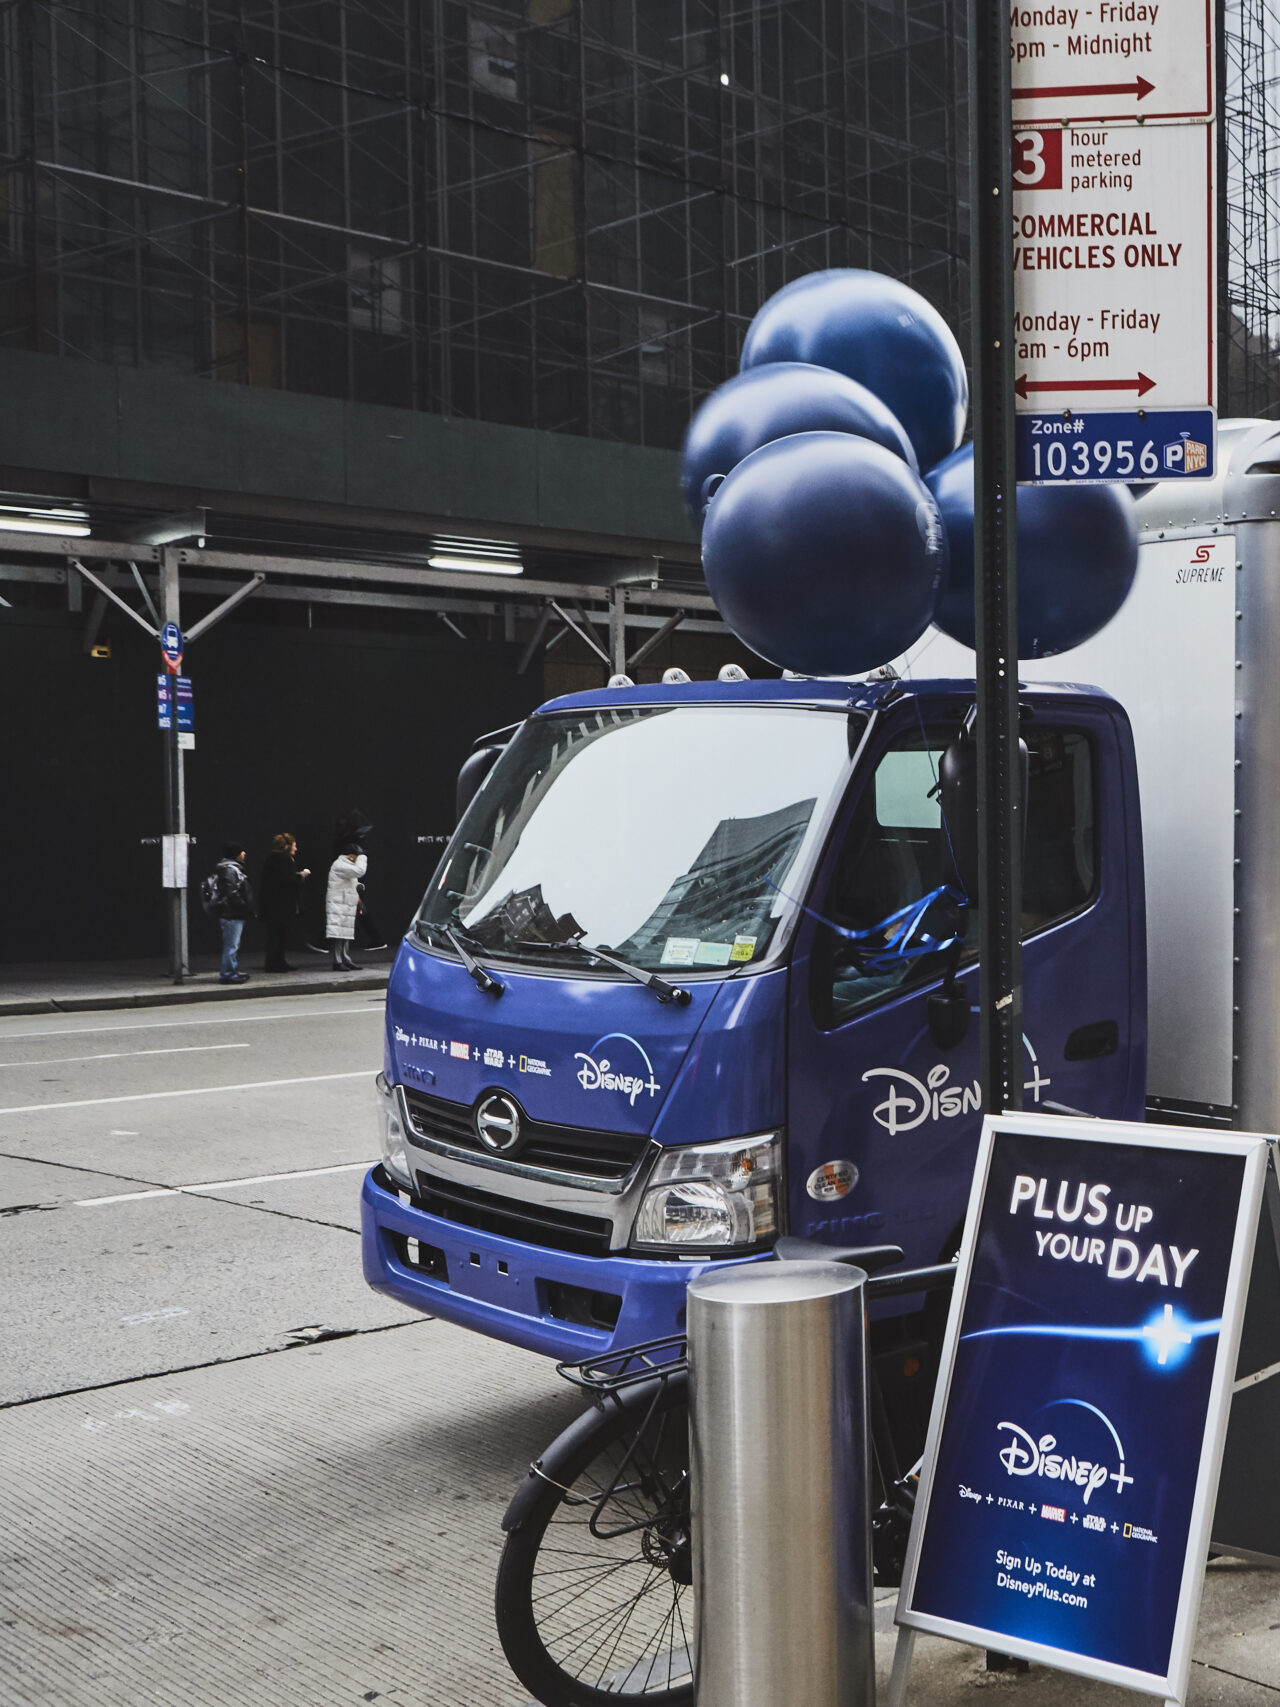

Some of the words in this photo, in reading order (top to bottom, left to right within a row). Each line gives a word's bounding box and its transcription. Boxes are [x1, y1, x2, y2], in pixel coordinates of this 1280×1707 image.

[1100, 2, 1159, 25] Friday
[1067, 32, 1152, 57] Midnight
[1071, 129, 1108, 146] hour
[1012, 131, 1046, 185] 3
[1071, 149, 1141, 167] metered
[1071, 171, 1133, 192] parking
[1124, 243, 1182, 268] ONLY
[1101, 308, 1160, 333] Friday
[1015, 339, 1046, 359] am
[1067, 338, 1109, 362] 6pm
[1031, 419, 1084, 434] Zone#
[1032, 440, 1158, 476] 103956
[1166, 445, 1183, 467] P
[1186, 442, 1205, 456] PARK
[1186, 454, 1206, 471] NYC
[1175, 567, 1225, 584] SUPREME
[419, 1037, 438, 1050] PIXAR
[574, 1052, 661, 1106] Disney+
[1010, 1175, 1111, 1225] PLUS
[1115, 1203, 1153, 1233] UP
[1035, 1231, 1105, 1265] YOUR
[1107, 1238, 1199, 1288] DAY
[997, 1421, 1134, 1504] Disney+
[958, 1484, 982, 1504] Disney
[997, 1497, 1024, 1511] PIXAR
[1041, 1504, 1066, 1522] MARVEL
[1083, 1519, 1106, 1532] WARS
[1086, 1514, 1105, 1525] STAR
[1132, 1526, 1153, 1536] NATIONAL
[1131, 1532, 1158, 1543] GEOGRAPHIC
[996, 1550, 1021, 1570] Sign
[1024, 1556, 1041, 1575] Up
[1045, 1561, 1081, 1586] Today
[1082, 1574, 1096, 1588] at
[997, 1573, 1088, 1608] DisneyPlus.com
